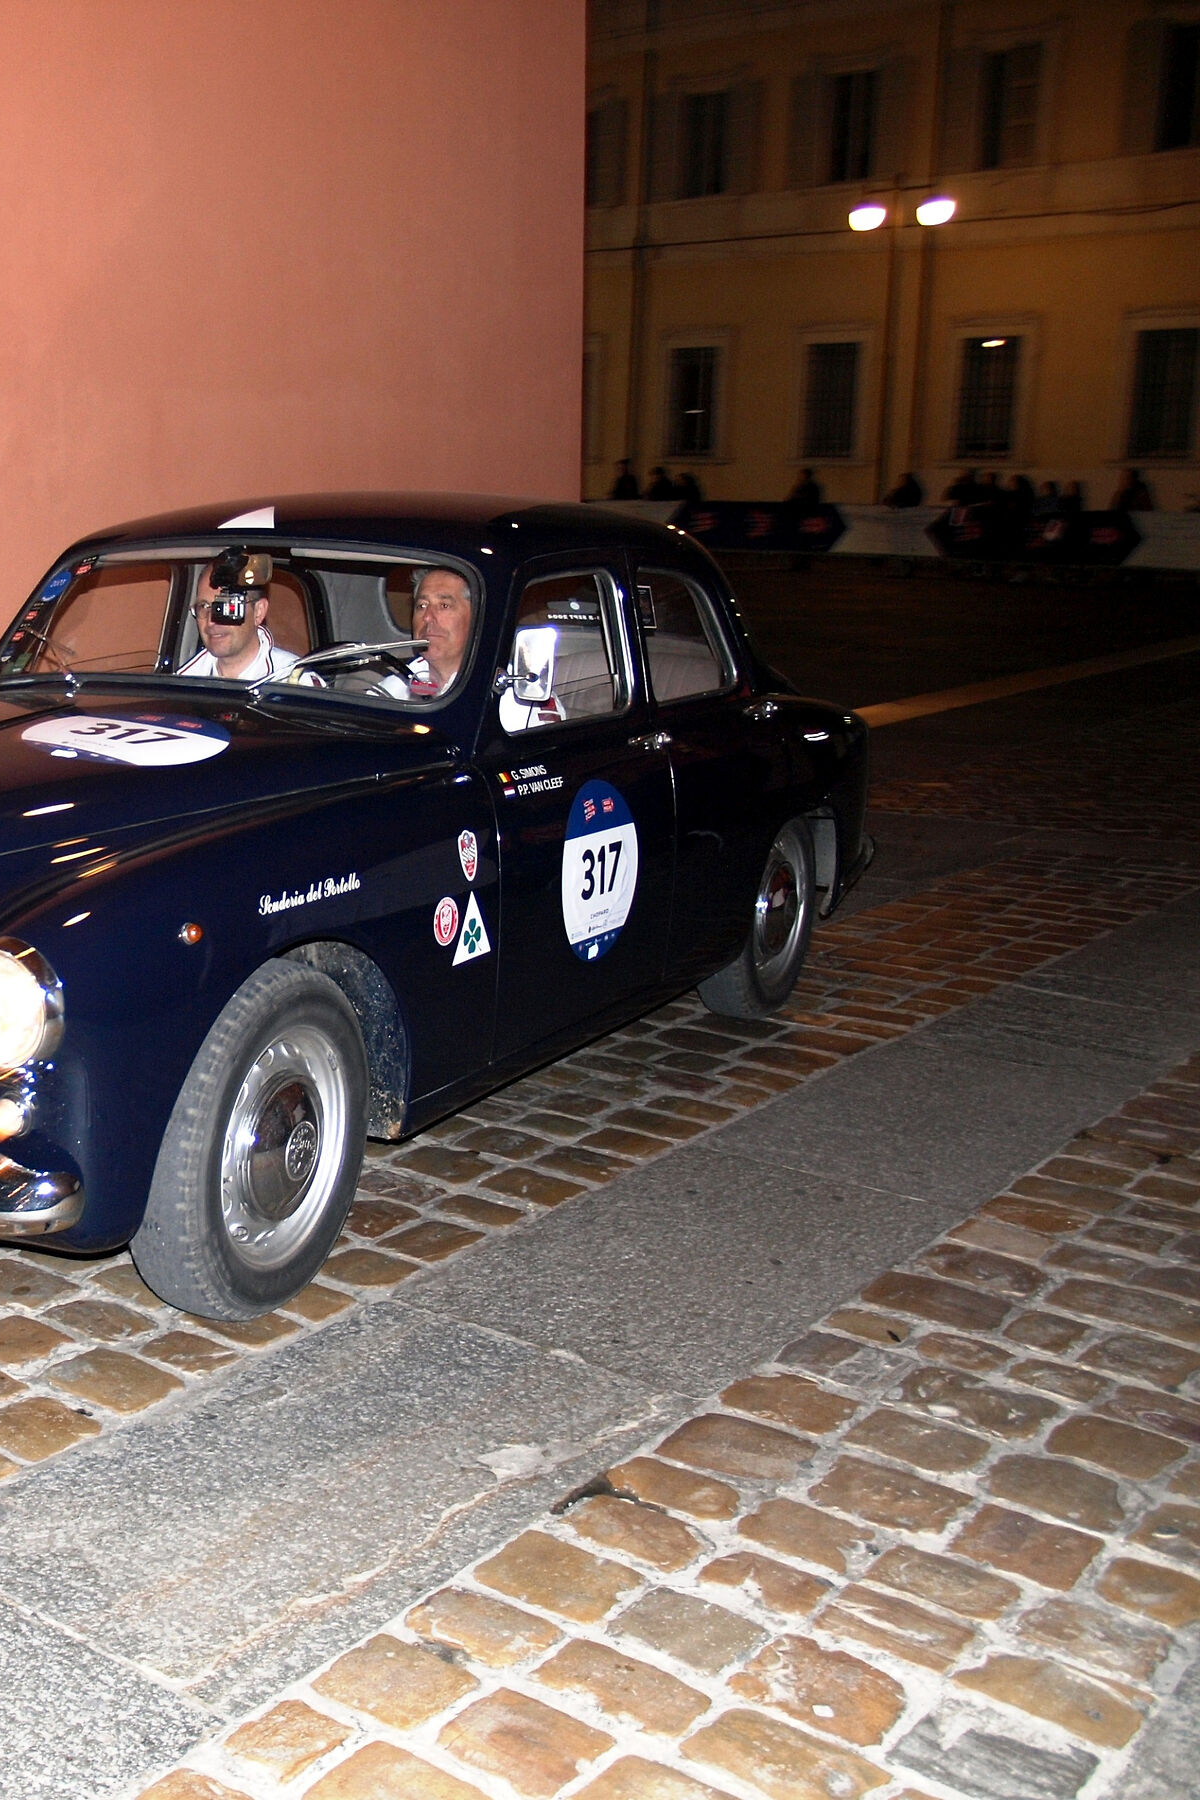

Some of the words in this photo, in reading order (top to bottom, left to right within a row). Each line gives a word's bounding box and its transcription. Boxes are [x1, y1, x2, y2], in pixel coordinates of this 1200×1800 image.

[70, 722, 187, 744] 317
[511, 770, 521, 781] G.
[519, 764, 547, 779] SIMONS
[529, 780, 544, 793] VAN
[543, 776, 564, 790] CLEEF
[581, 840, 622, 900] 317
[258, 890, 305, 915] Scuderia
[306, 881, 322, 903] del
[323, 872, 360, 898] Portello
